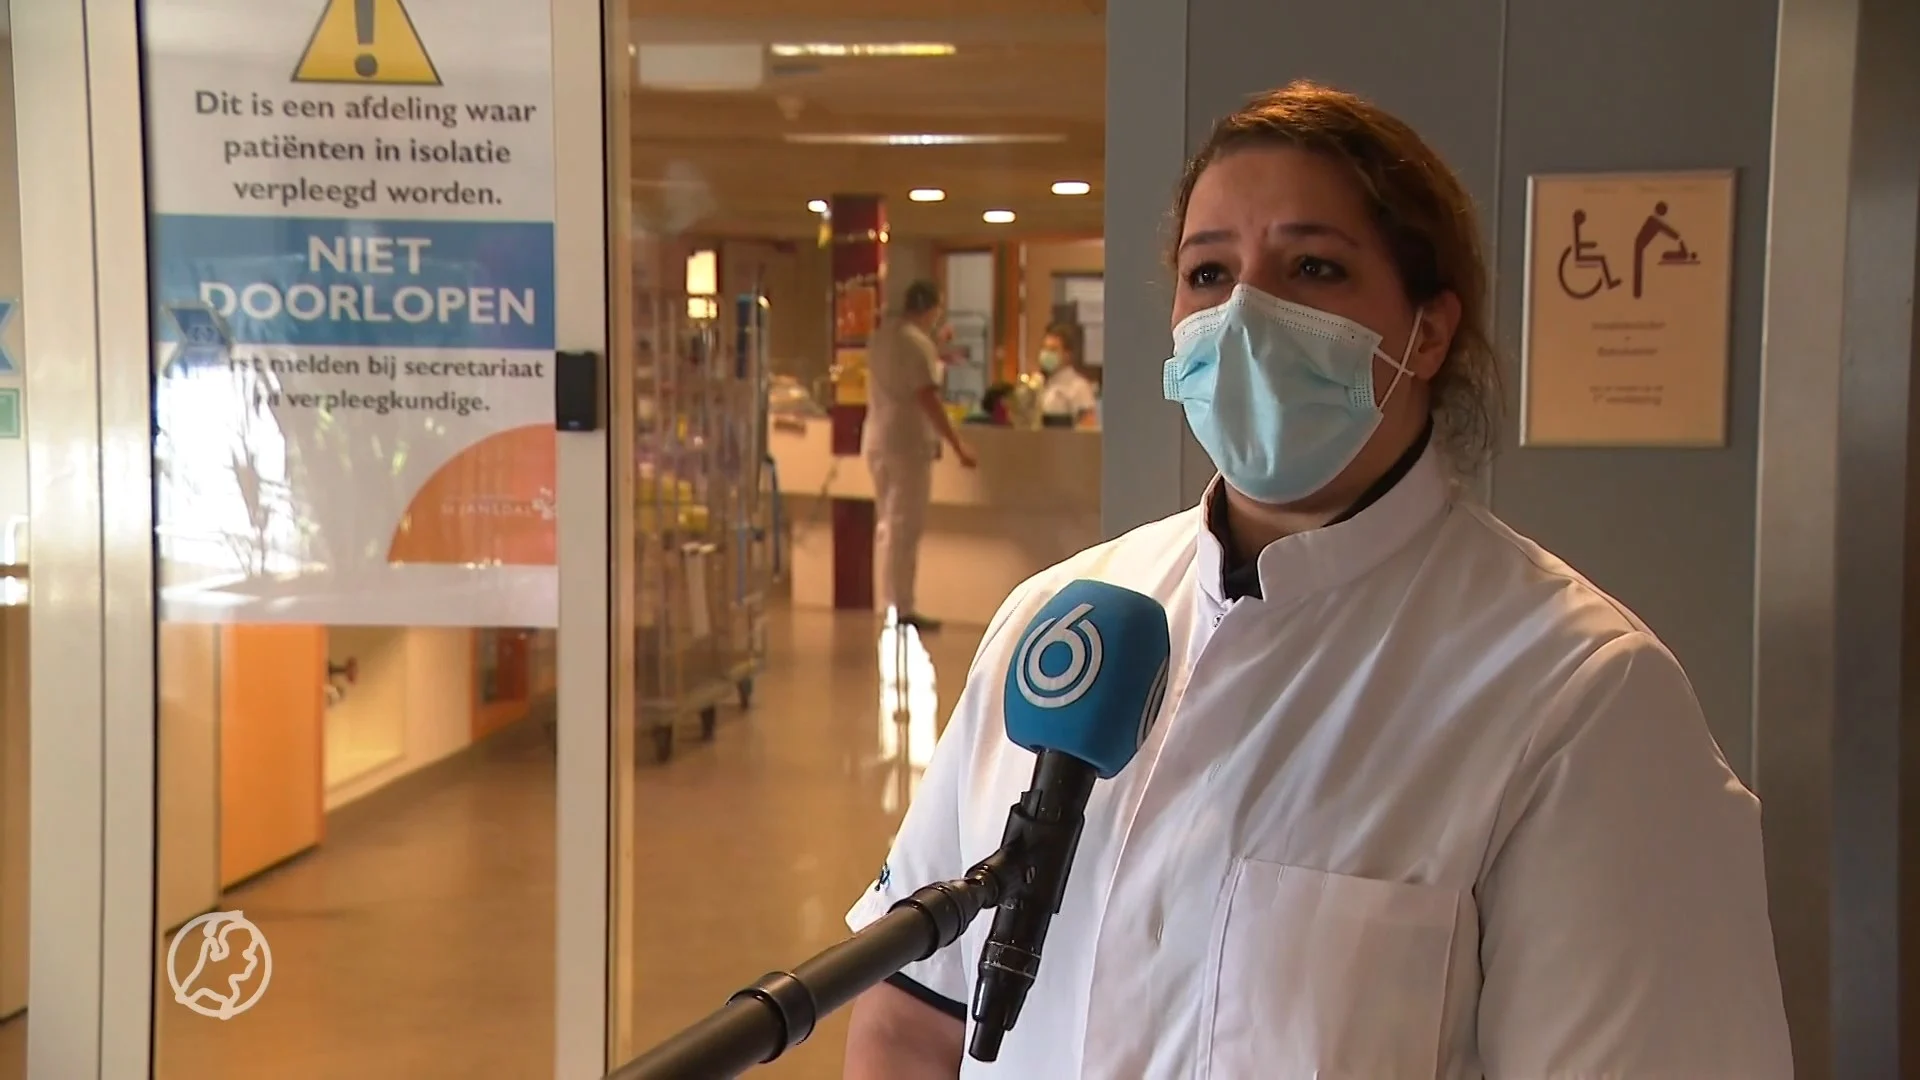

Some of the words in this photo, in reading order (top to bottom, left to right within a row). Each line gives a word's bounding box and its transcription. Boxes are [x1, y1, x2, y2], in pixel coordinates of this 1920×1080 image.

[195, 89, 242, 117] Dit
[251, 92, 274, 117] is
[282, 99, 334, 119] een
[345, 94, 458, 129] afdeling
[465, 102, 537, 122] waar
[223, 134, 366, 165] patiënten
[375, 136, 400, 162] in
[410, 137, 512, 165] isolatie
[233, 177, 376, 209] verpleegd
[386, 180, 503, 206] worden.
[308, 235, 432, 275] NIET
[199, 281, 536, 326] DOORLOPEN
[270, 353, 360, 375] melden
[368, 355, 397, 381] bij
[404, 357, 545, 379] secretariaat
[285, 389, 492, 417] verpleegkundige.
